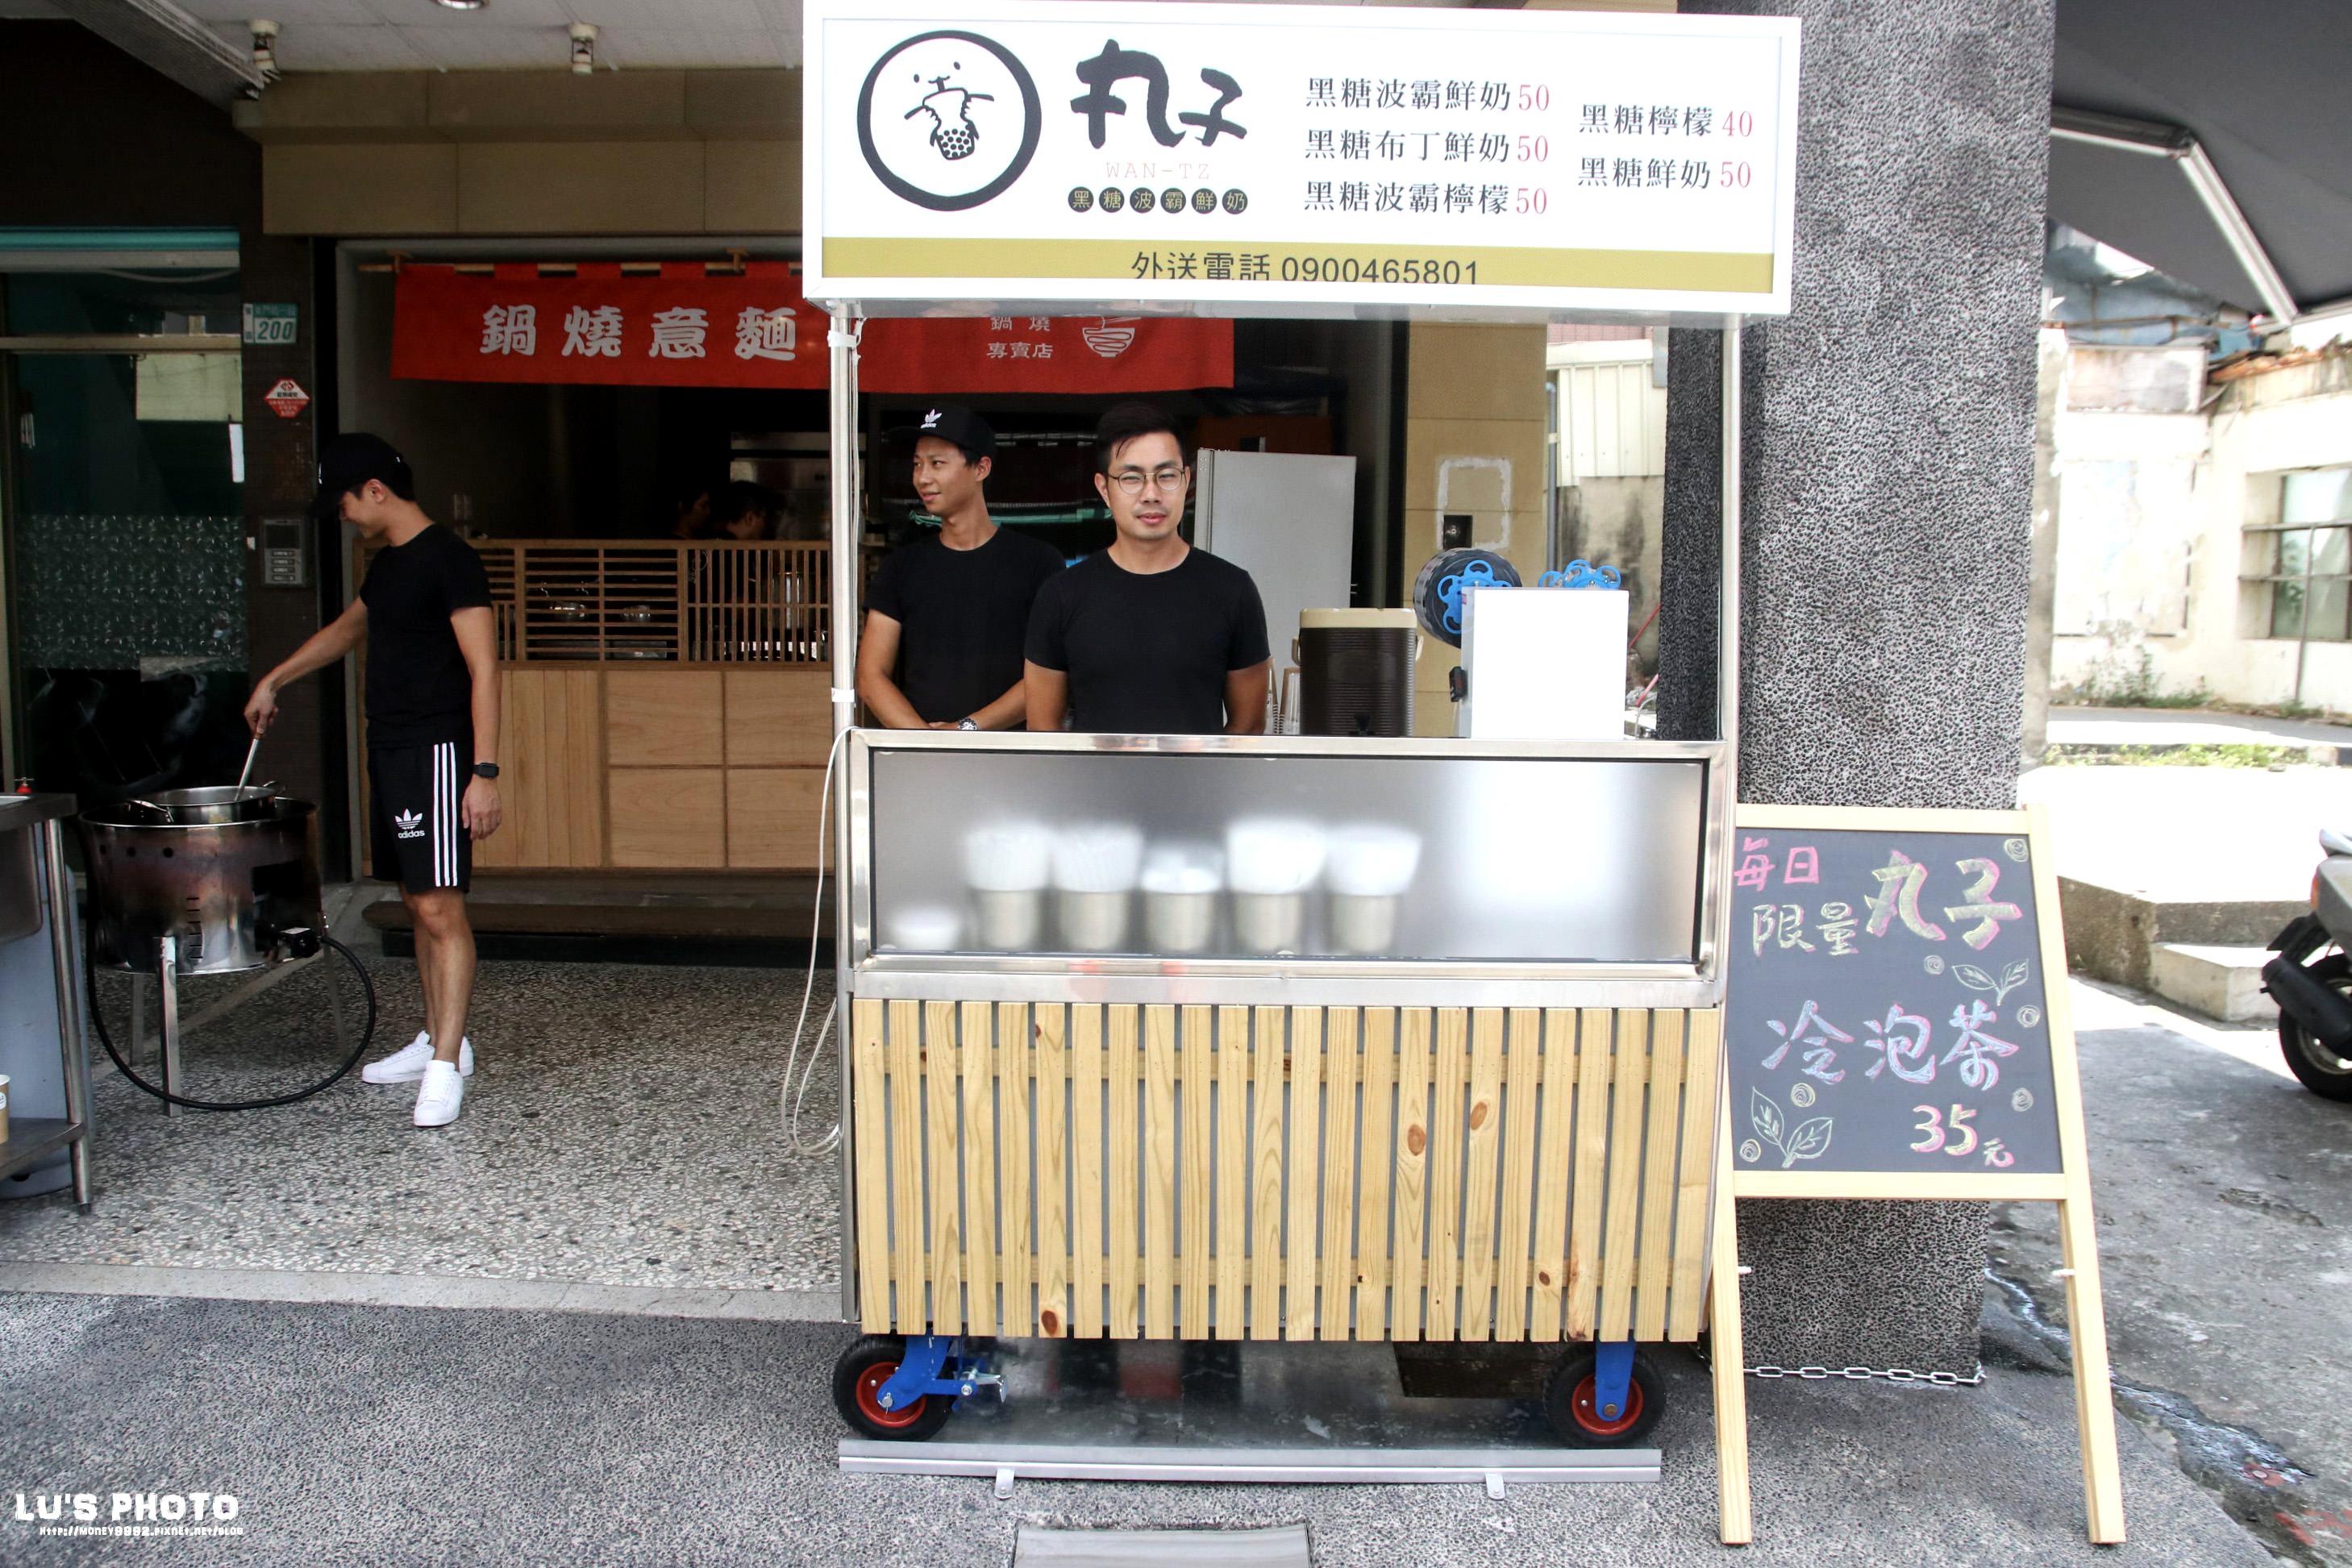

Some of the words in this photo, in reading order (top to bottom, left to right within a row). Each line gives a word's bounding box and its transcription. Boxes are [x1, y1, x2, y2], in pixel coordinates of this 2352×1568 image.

[1070, 38, 1247, 150] 丸子
[1305, 77, 1511, 111] 黑糖波霸鮮奶
[1518, 84, 1550, 111] 50
[1579, 103, 1713, 137] 黑糖檸檬
[1721, 110, 1753, 137] 40
[1305, 129, 1510, 163] 黑糖布丁鮮奶
[1517, 135, 1549, 163] 50
[1578, 156, 1711, 189] 黑糖鮮奶
[1720, 160, 1751, 189] 50
[1069, 187, 1247, 213] 黑糖波霸鮮奶
[1304, 181, 1509, 215] 黑糖波霸檸檬
[1516, 187, 1547, 215] 50
[1130, 251, 1271, 281] 外送電話
[1281, 256, 1477, 285] 0900465801
[257, 320, 293, 340] 200
[478, 303, 797, 362] 鍋燒意麵
[986, 342, 1054, 360] 專賣店
[398, 830, 426, 839] adidas
[1734, 837, 1820, 892] 每日
[1864, 849, 2023, 951] 丸子
[1751, 901, 1859, 957] 限量
[1761, 998, 2020, 1092] 冷泡茶
